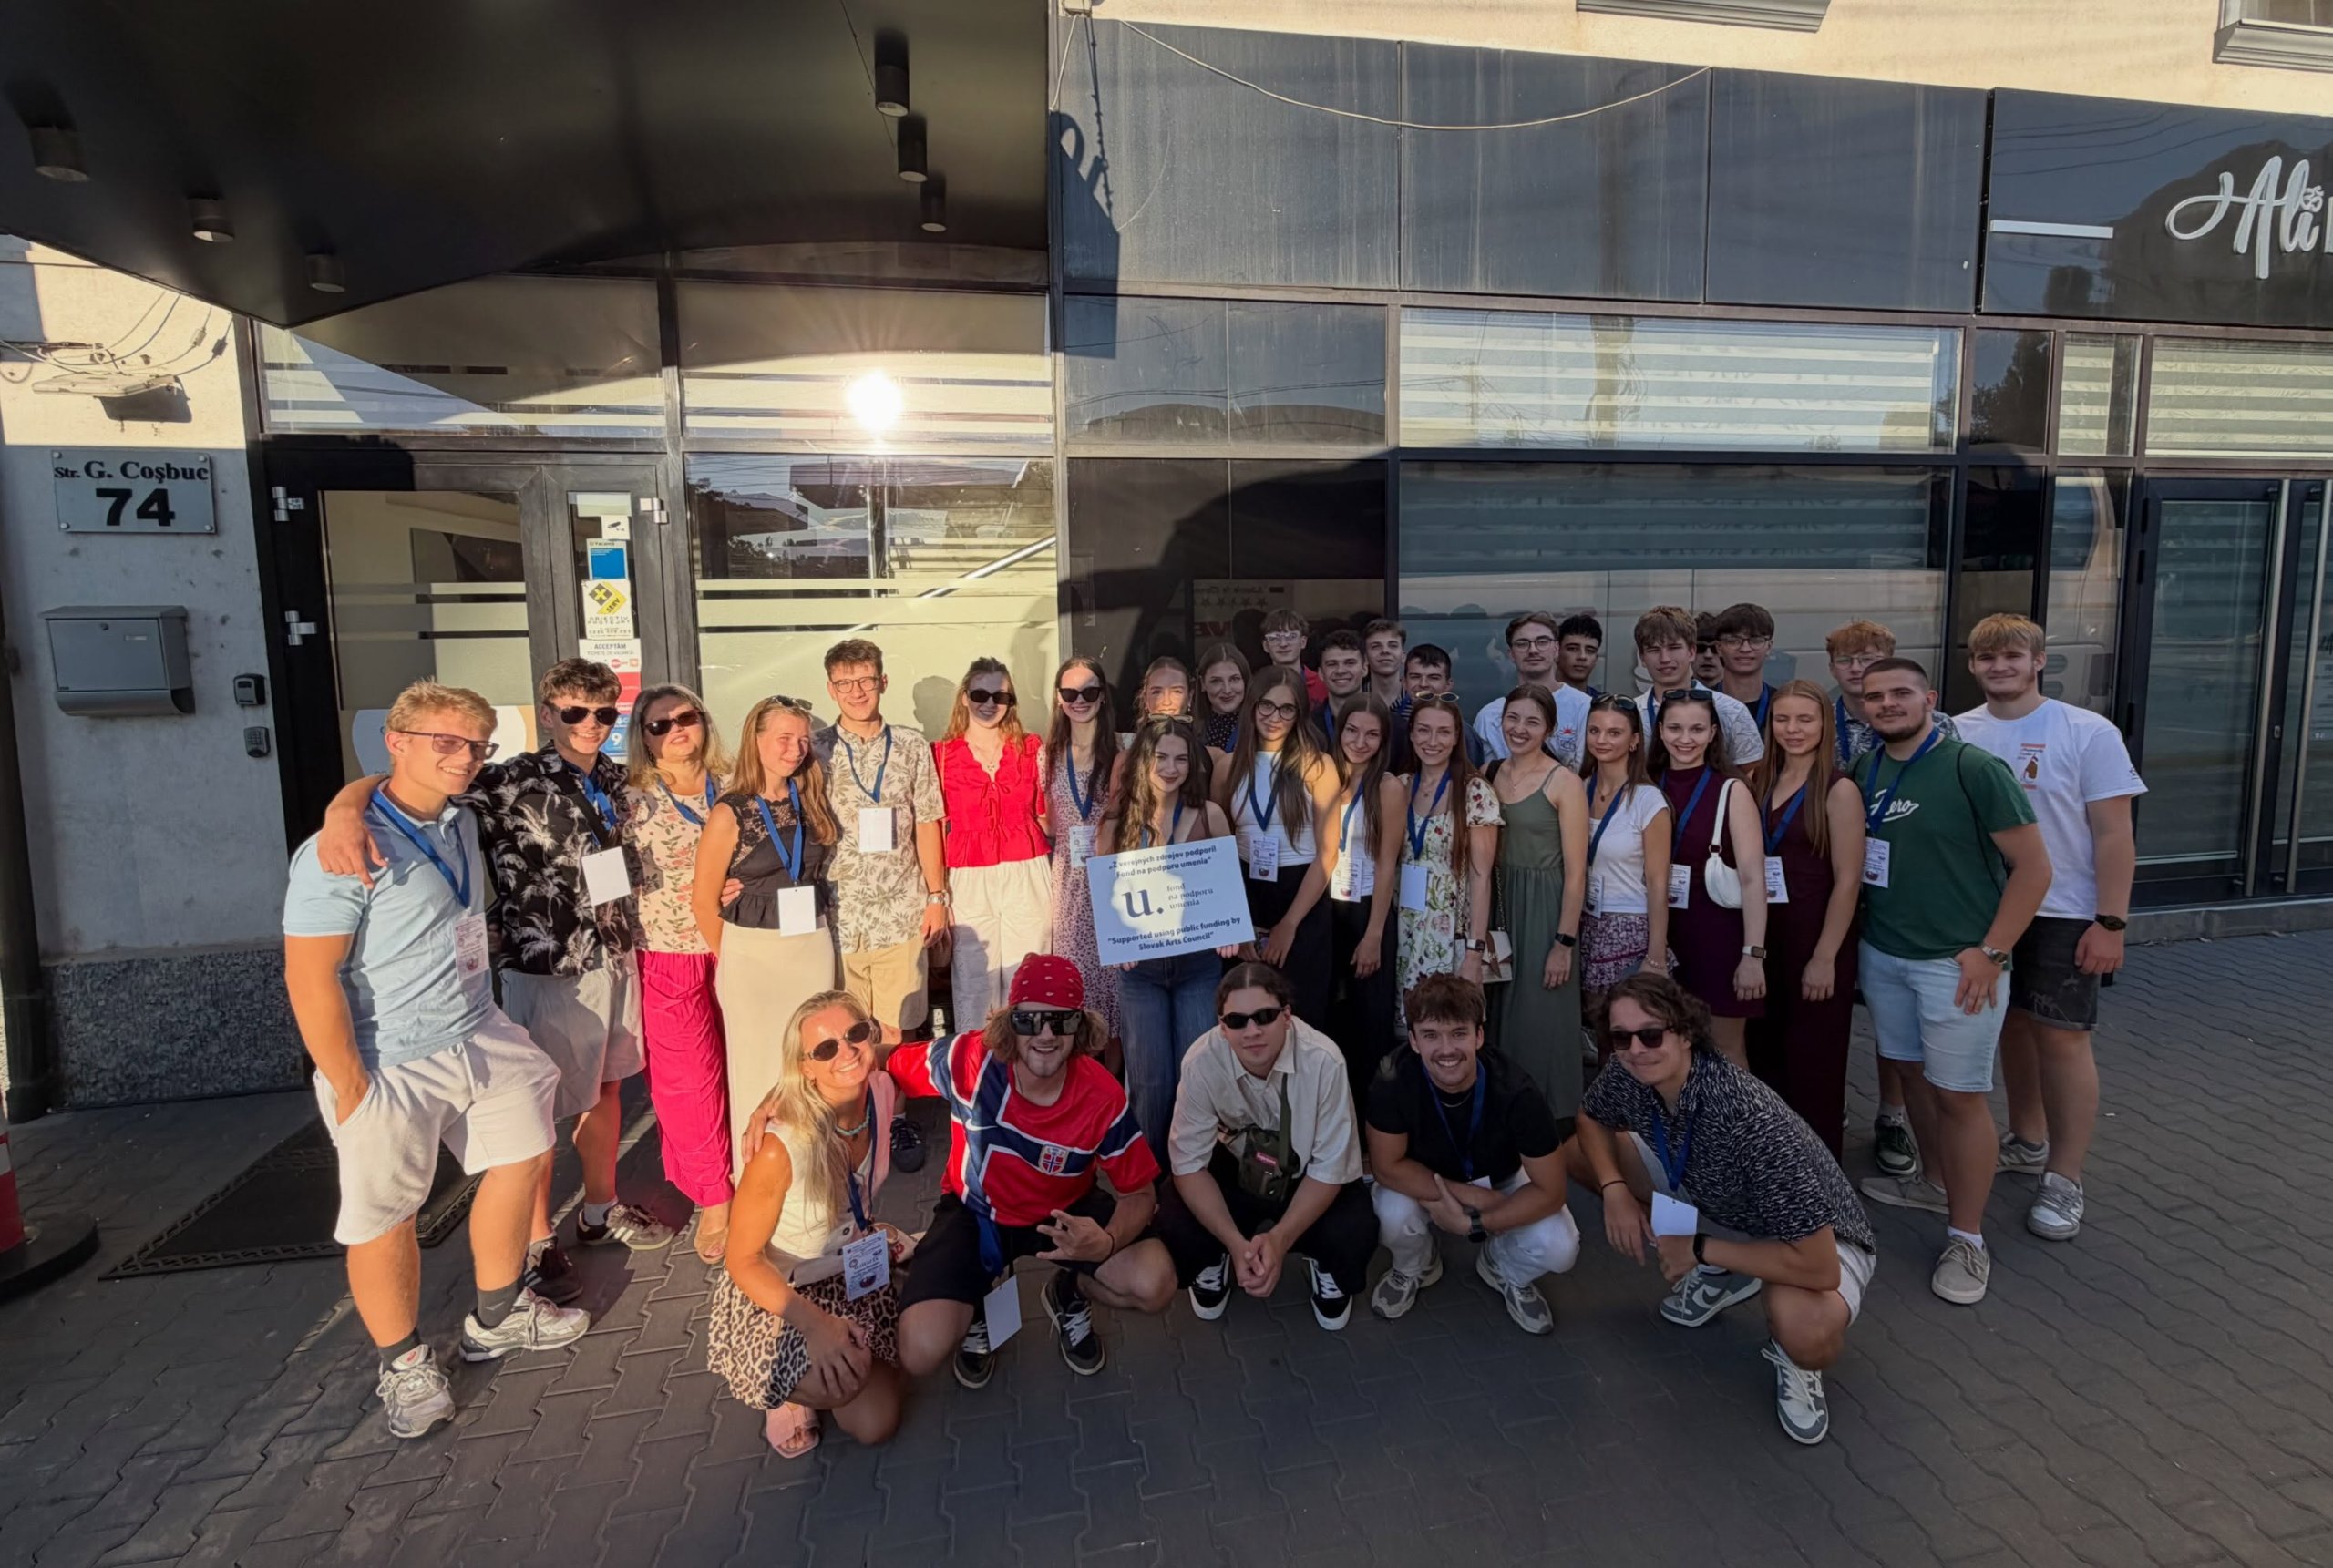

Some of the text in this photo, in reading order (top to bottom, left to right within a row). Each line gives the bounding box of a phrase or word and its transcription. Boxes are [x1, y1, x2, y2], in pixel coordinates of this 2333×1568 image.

[54, 466, 81, 478] Str.
[84, 460, 114, 479] G.
[96, 488, 176, 527] 74
[606, 597, 620, 613] SERV
[1156, 852, 1184, 862] zdrojov
[1185, 845, 1217, 858] podporil
[1116, 869, 1136, 878] Fond
[1147, 863, 1179, 874] podporu
[1166, 883, 1186, 892] fond
[1180, 888, 1214, 899] podporu
[1122, 889, 1165, 918] u.
[1169, 899, 1200, 909] umenia
[1154, 929, 1176, 938] using
[1176, 924, 1200, 936] public
[1200, 918, 1230, 930] funding
[1231, 917, 1241, 925] by
[1138, 941, 1165, 950] Slovak
[1166, 938, 1182, 947] Arts
